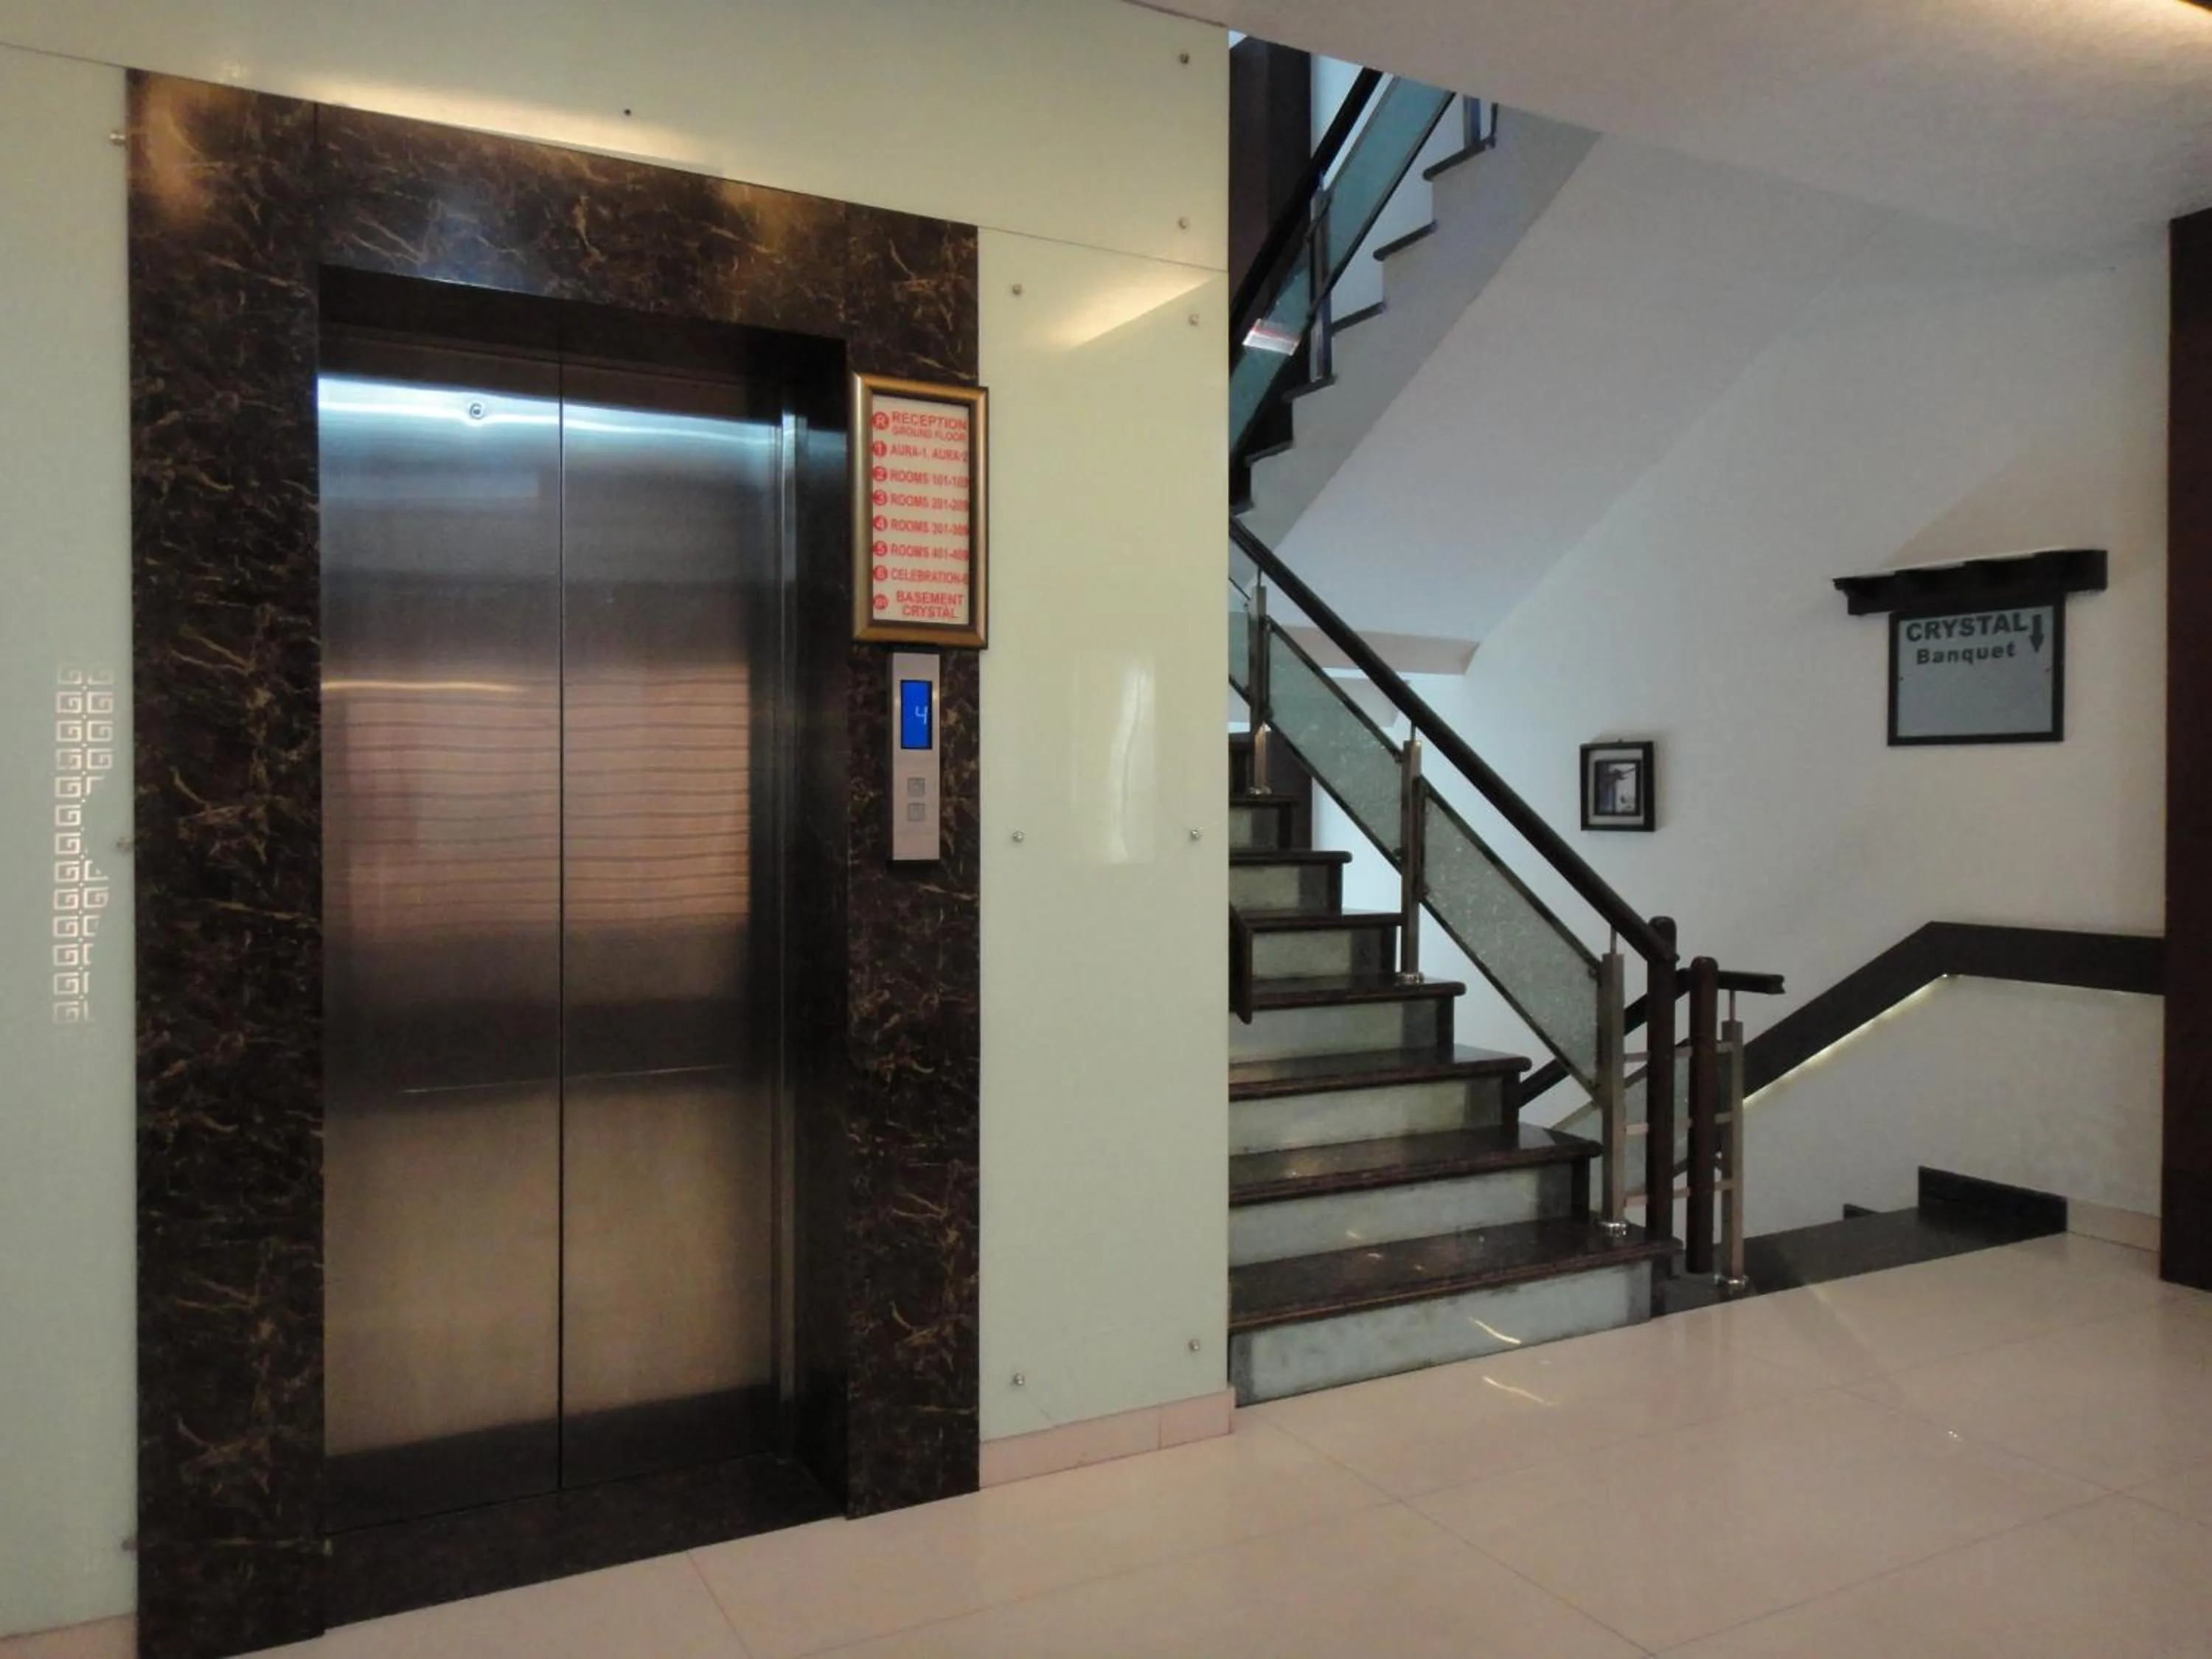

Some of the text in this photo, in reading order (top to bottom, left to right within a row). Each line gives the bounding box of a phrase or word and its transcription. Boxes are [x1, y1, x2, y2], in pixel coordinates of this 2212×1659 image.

[892, 411, 967, 430] RECEPTION
[892, 425, 967, 441] GROUND FLOOR
[890, 468, 929, 484] ROOMS
[932, 473, 967, 488] 101-1
[890, 493, 929, 508] ROOMS
[891, 518, 929, 533] ROOMS
[891, 543, 929, 558] ROOMS
[896, 590, 964, 605] BASEMENT
[902, 605, 959, 618] CRYSTAL
[1906, 613, 2029, 642] CRYSTAL
[1916, 640, 2016, 665] Banquet
